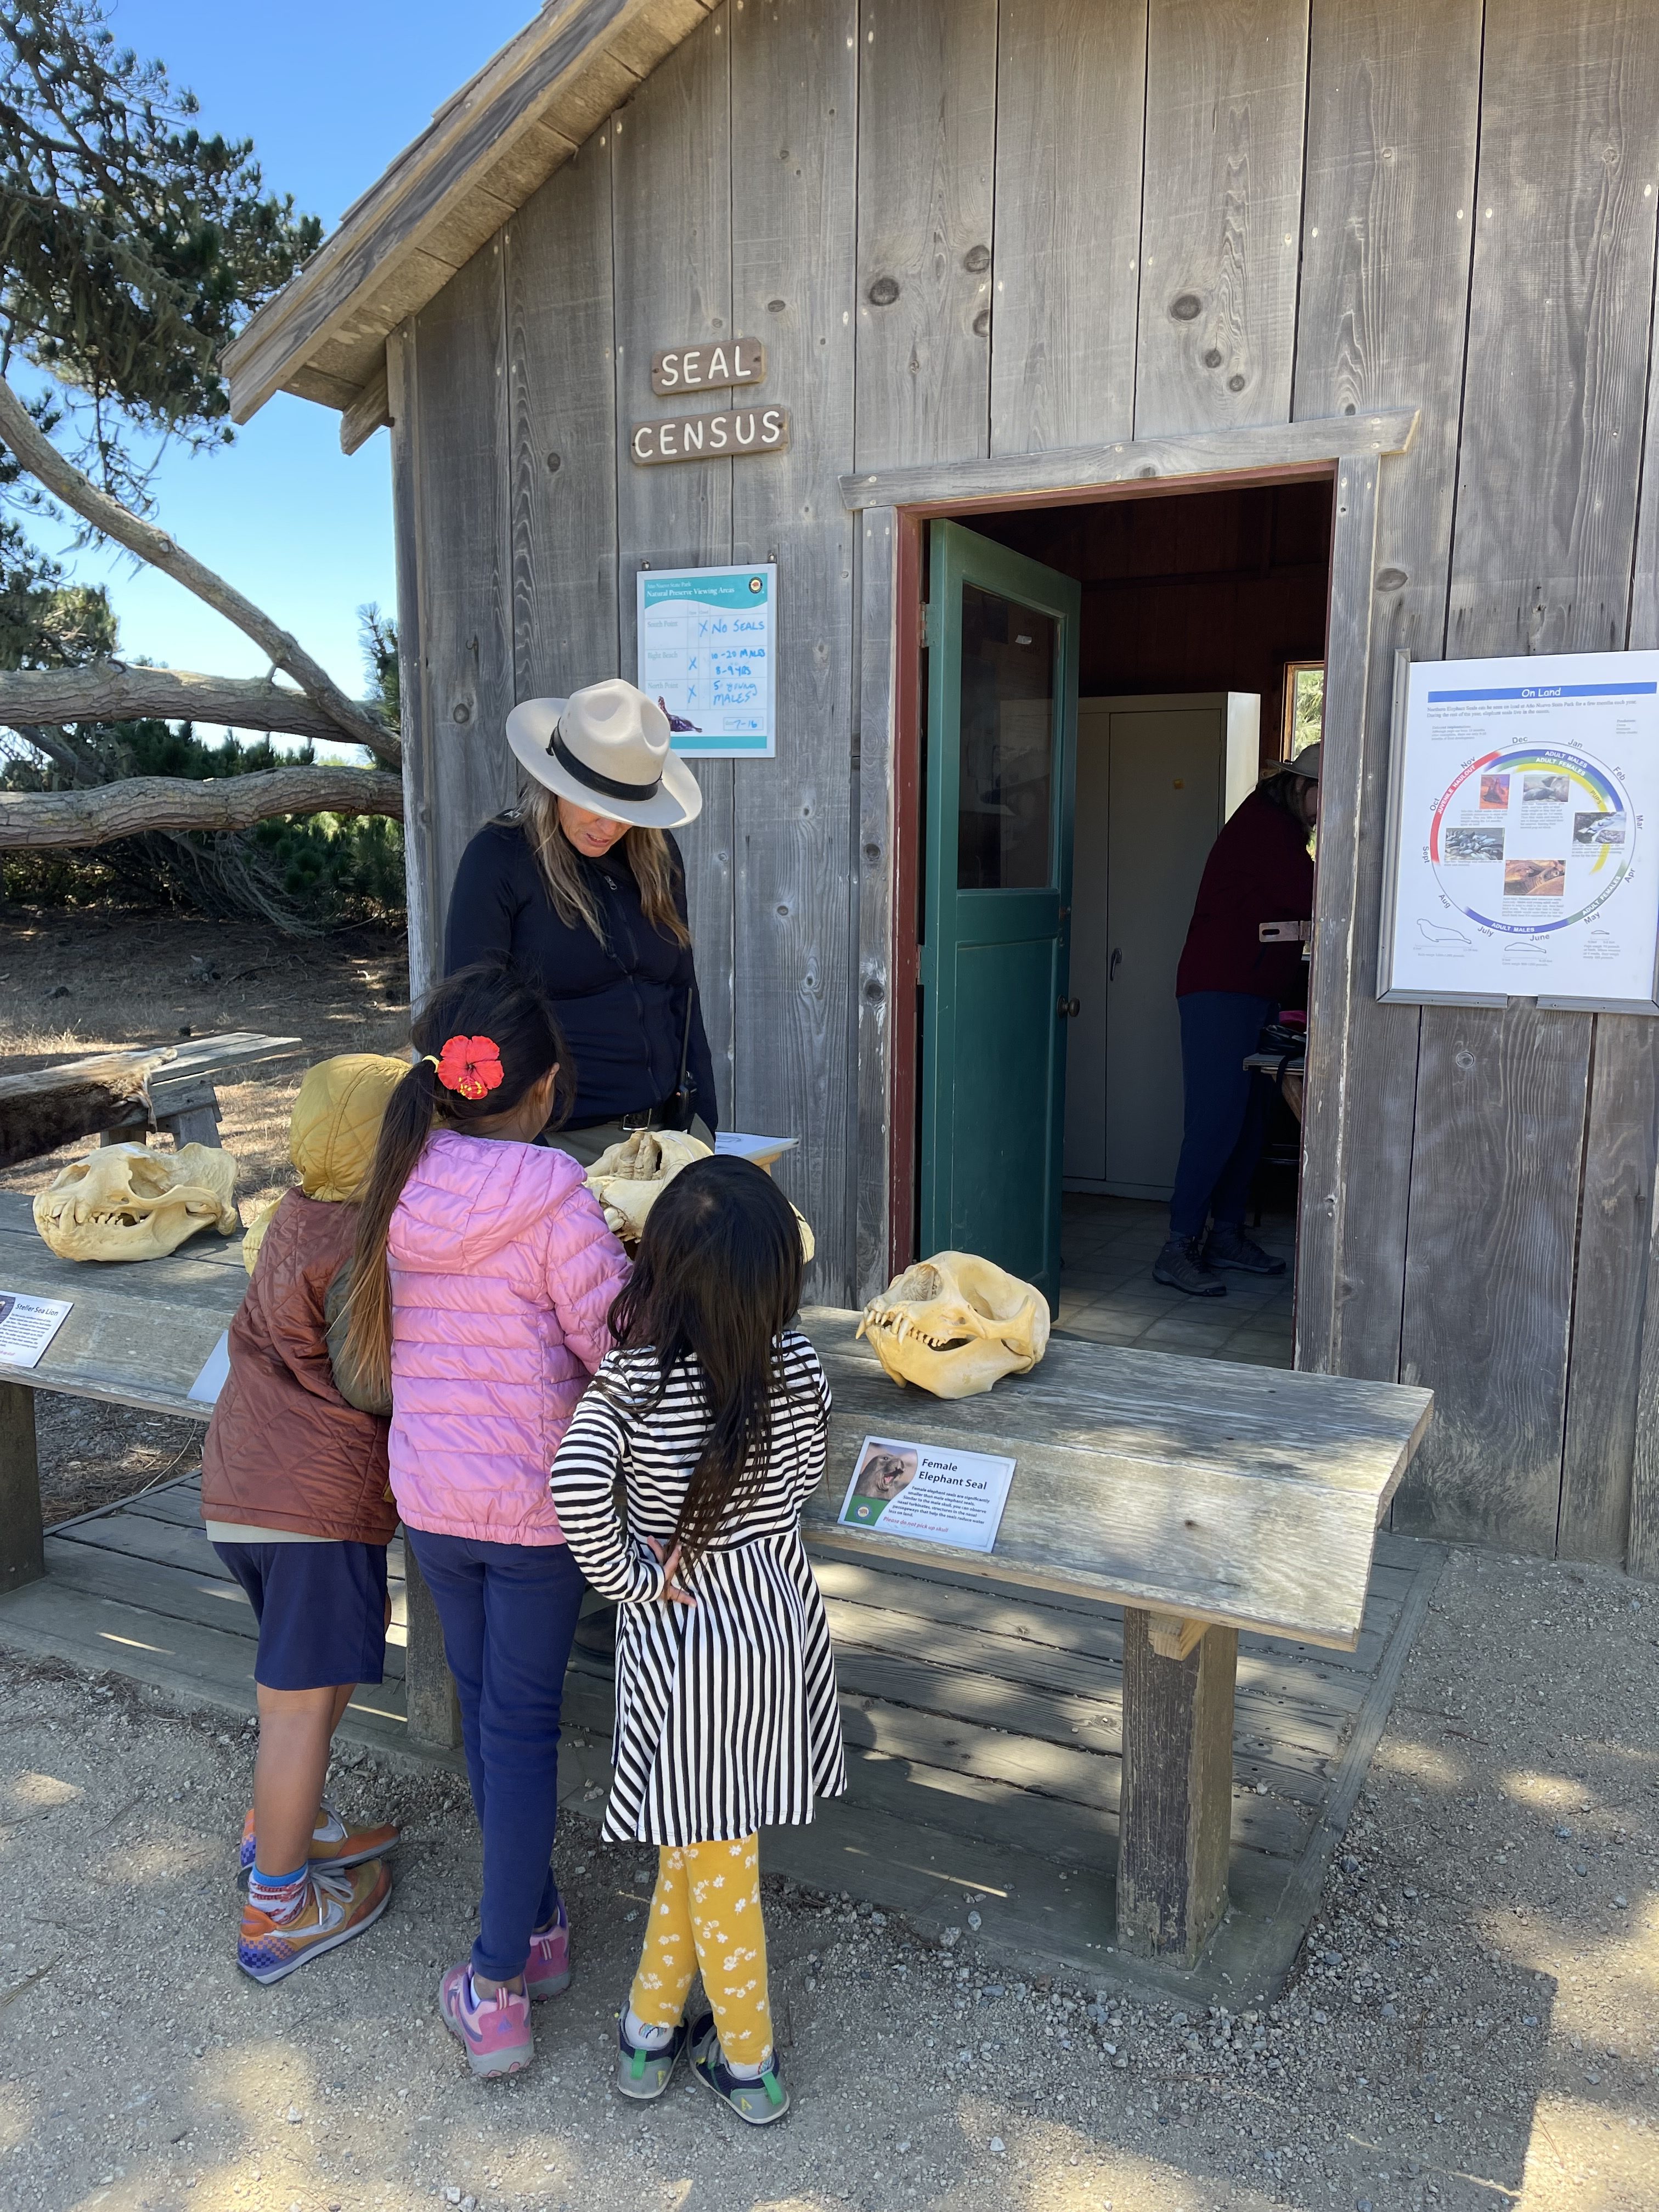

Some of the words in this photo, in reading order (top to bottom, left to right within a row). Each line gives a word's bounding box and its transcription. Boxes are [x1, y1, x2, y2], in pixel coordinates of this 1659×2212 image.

[661, 346, 751, 386] SEAL
[634, 410, 780, 458] CENSUS
[733, 619, 765, 633] SEALS
[740, 648, 765, 658] MALES
[714, 691, 750, 706] MALES
[1521, 689, 1536, 697] On
[1538, 687, 1561, 697] Land
[1567, 738, 1583, 749] Jan
[1460, 757, 1476, 769] Nov
[1544, 751, 1566, 759] ADULT
[1567, 756, 1588, 769] MALES
[1558, 760, 1585, 776] FEMALES
[1613, 766, 1625, 781] Feb
[1437, 788, 1454, 814] JUVENILE
[1452, 765, 1476, 787] HAULOUT
[1590, 790, 1601, 804] PUPS
[1430, 798, 1440, 811] Oct
[1422, 846, 1430, 864] Sept
[1624, 868, 1635, 883] Apr
[1438, 894, 1451, 909] Aug
[1582, 900, 1600, 916] ADULT
[1601, 876, 1621, 901] FEMALES
[1584, 911, 1600, 925] May
[1477, 926, 1494, 937] July
[1491, 922, 1511, 931] ADULT
[15, 1304, 34, 1312] Steller
[922, 1458, 957, 1471] Female
[918, 1471, 964, 1486] Elephant
[965, 1479, 987, 1489] Seal
